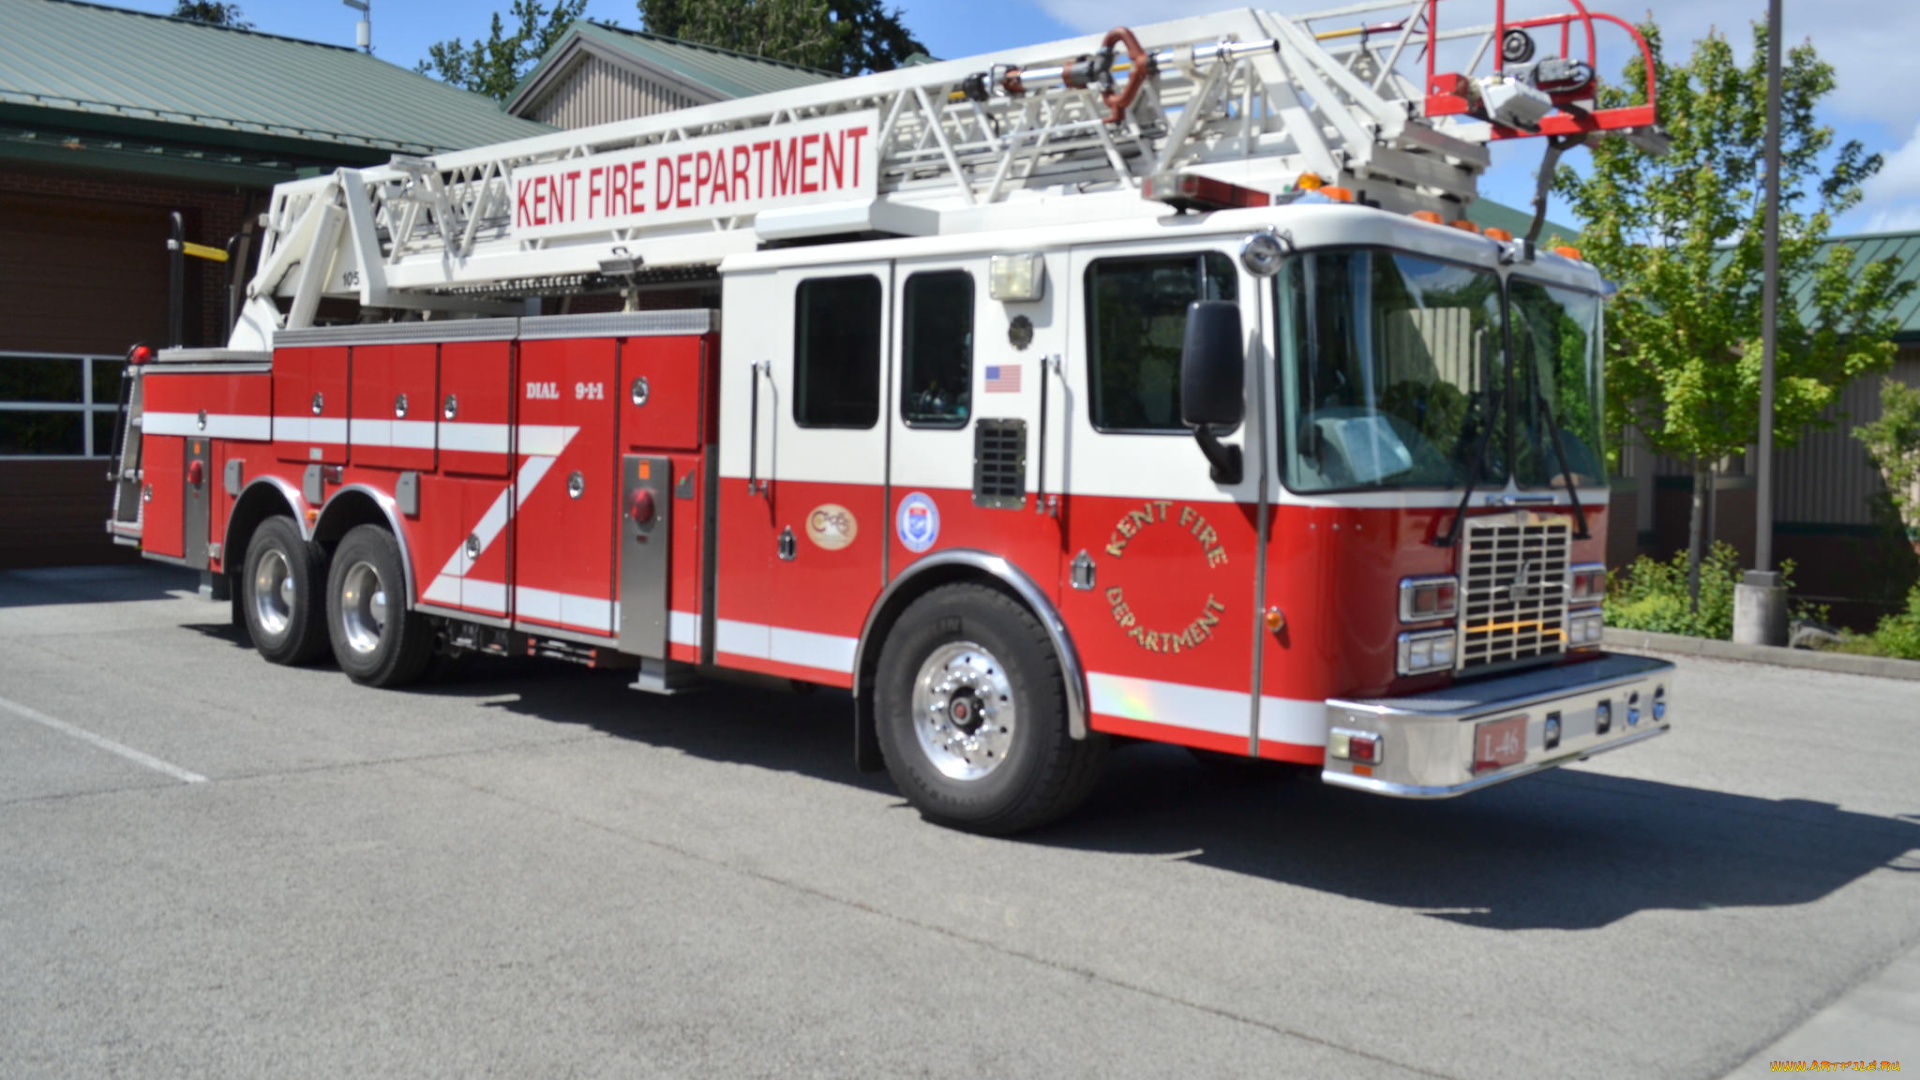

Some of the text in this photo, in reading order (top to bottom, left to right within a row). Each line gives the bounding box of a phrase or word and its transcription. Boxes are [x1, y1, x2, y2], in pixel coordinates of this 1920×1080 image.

[517, 126, 868, 228] KENT FIRE DEPARTMENT
[526, 382, 560, 399] DIAL
[1105, 500, 1228, 568] KENT FIRE
[1106, 586, 1225, 653] DEPARTMENT
[1484, 729, 1519, 762] L-46
